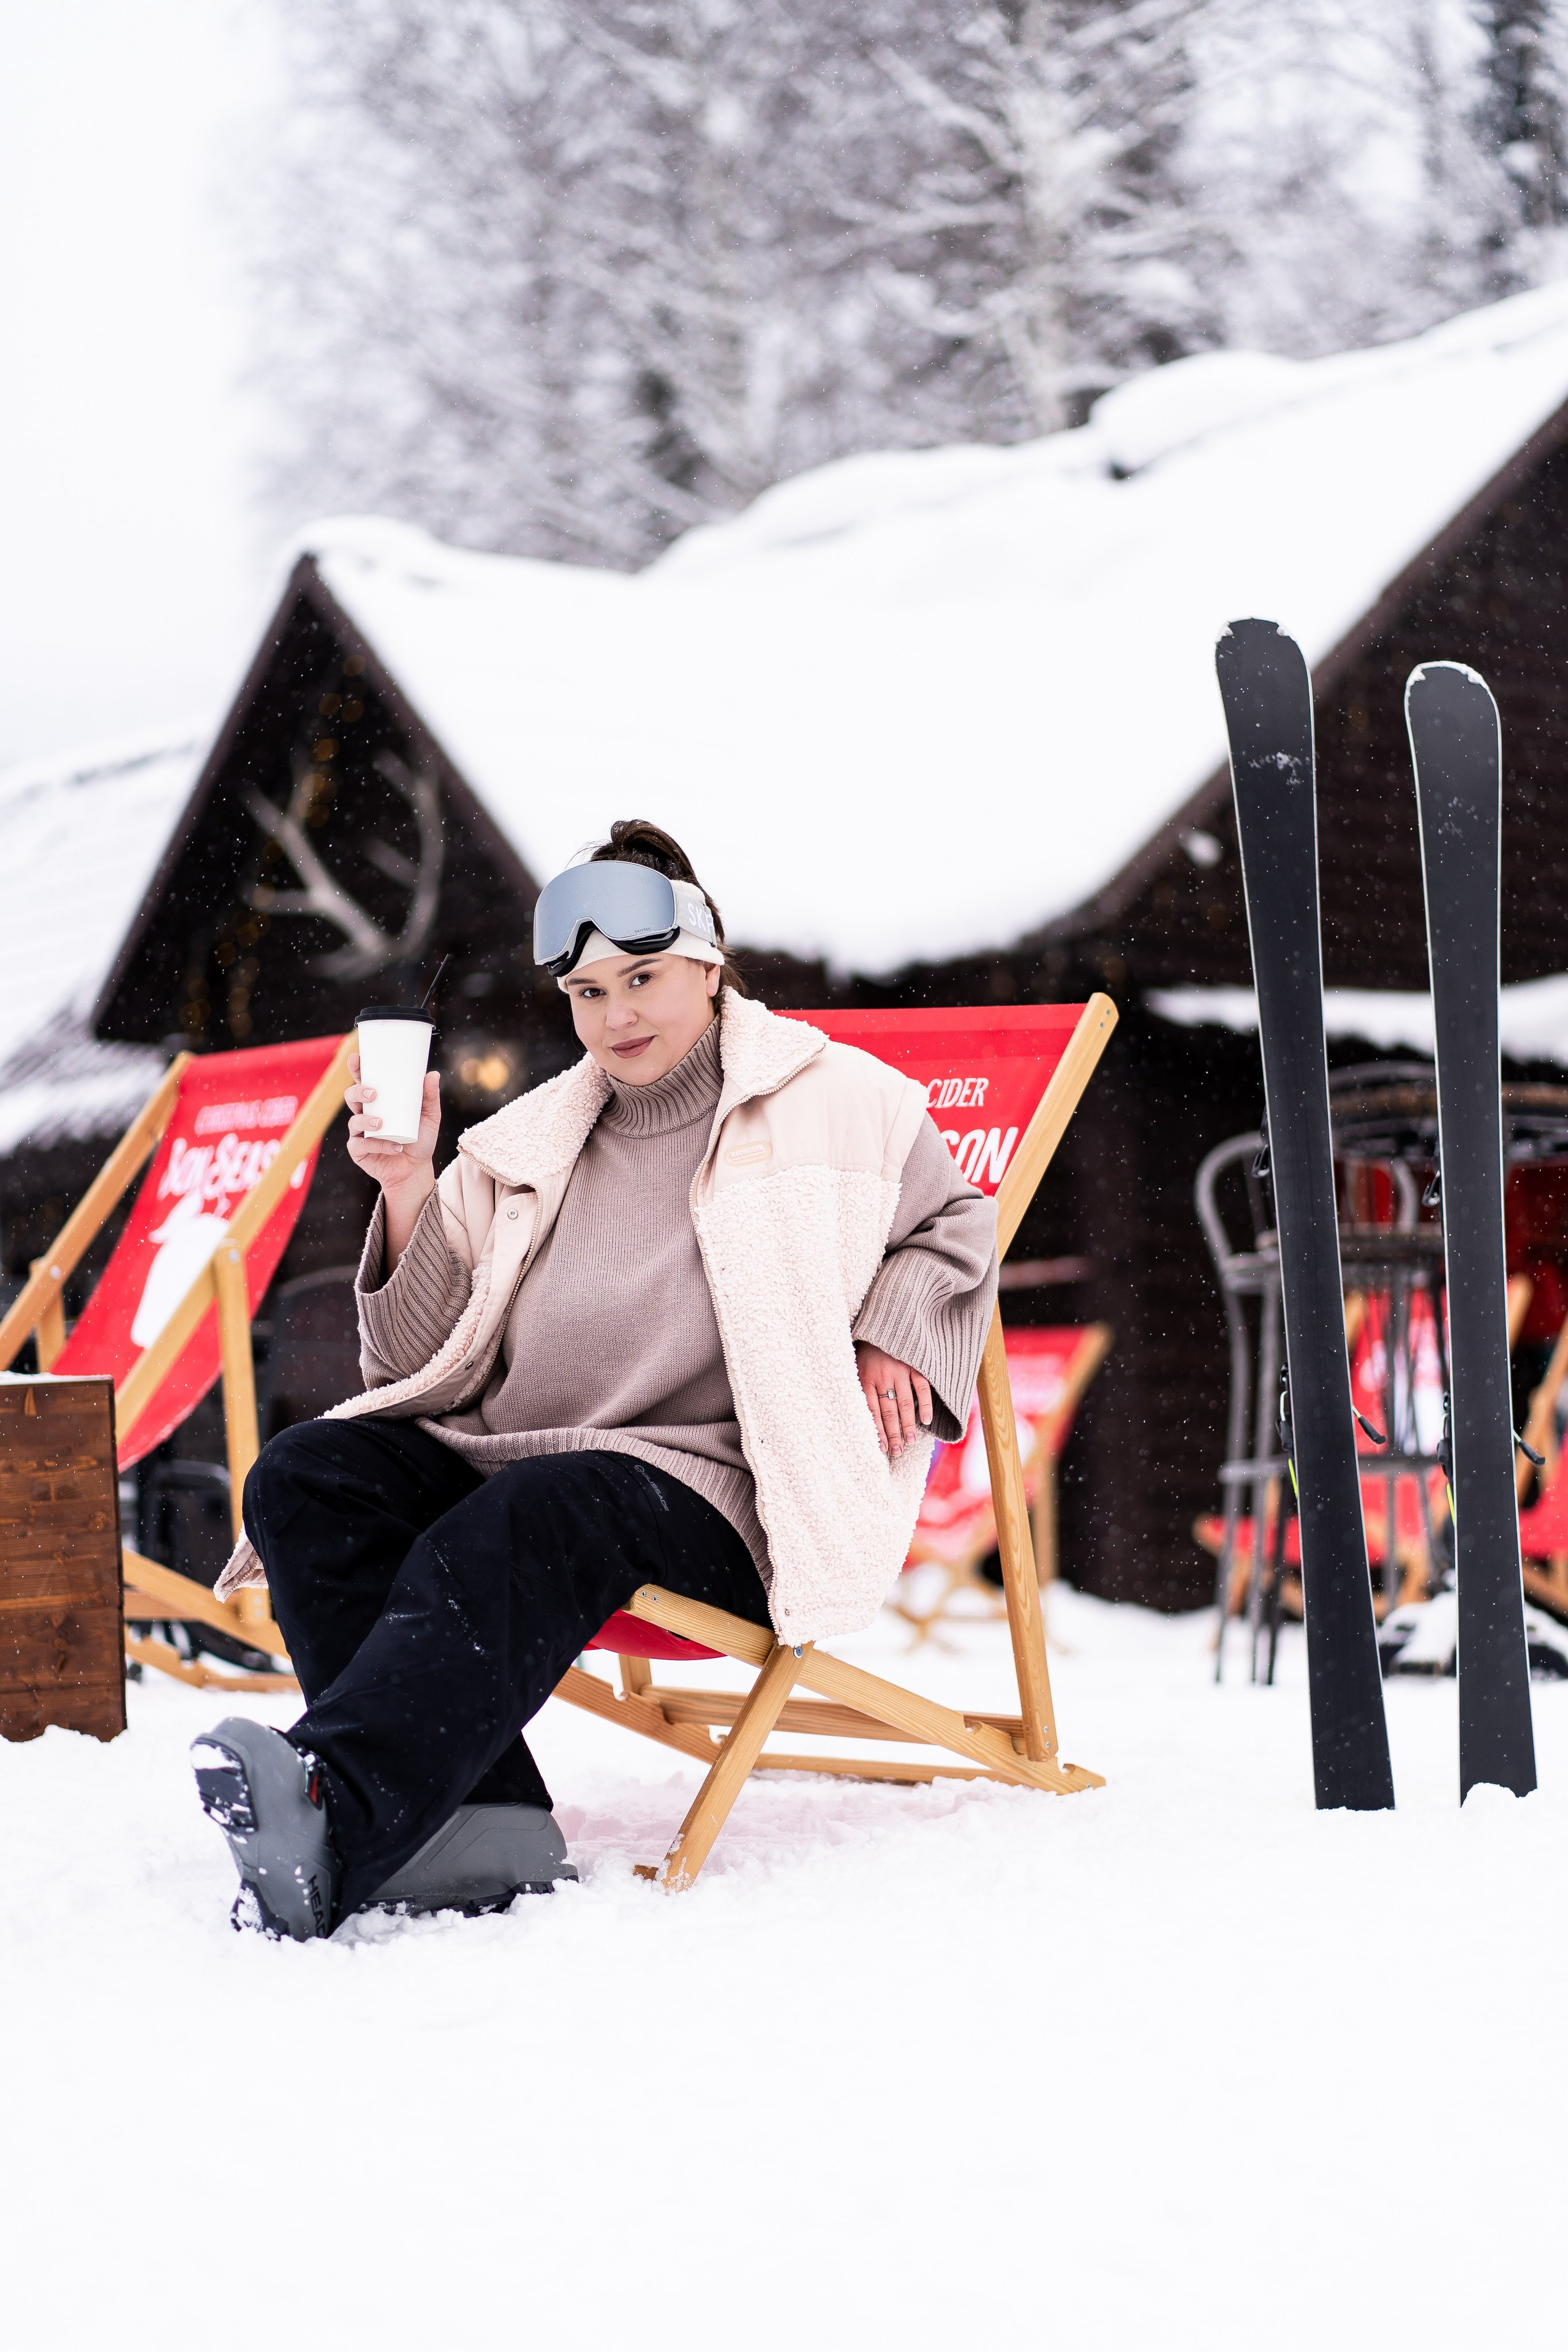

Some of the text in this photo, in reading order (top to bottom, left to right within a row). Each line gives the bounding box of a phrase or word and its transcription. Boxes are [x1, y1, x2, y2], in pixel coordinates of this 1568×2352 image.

[925, 1077, 989, 1109] CIDER
[642, 1472, 669, 1512] GLISSADE
[307, 1874, 326, 1938] HEAD
